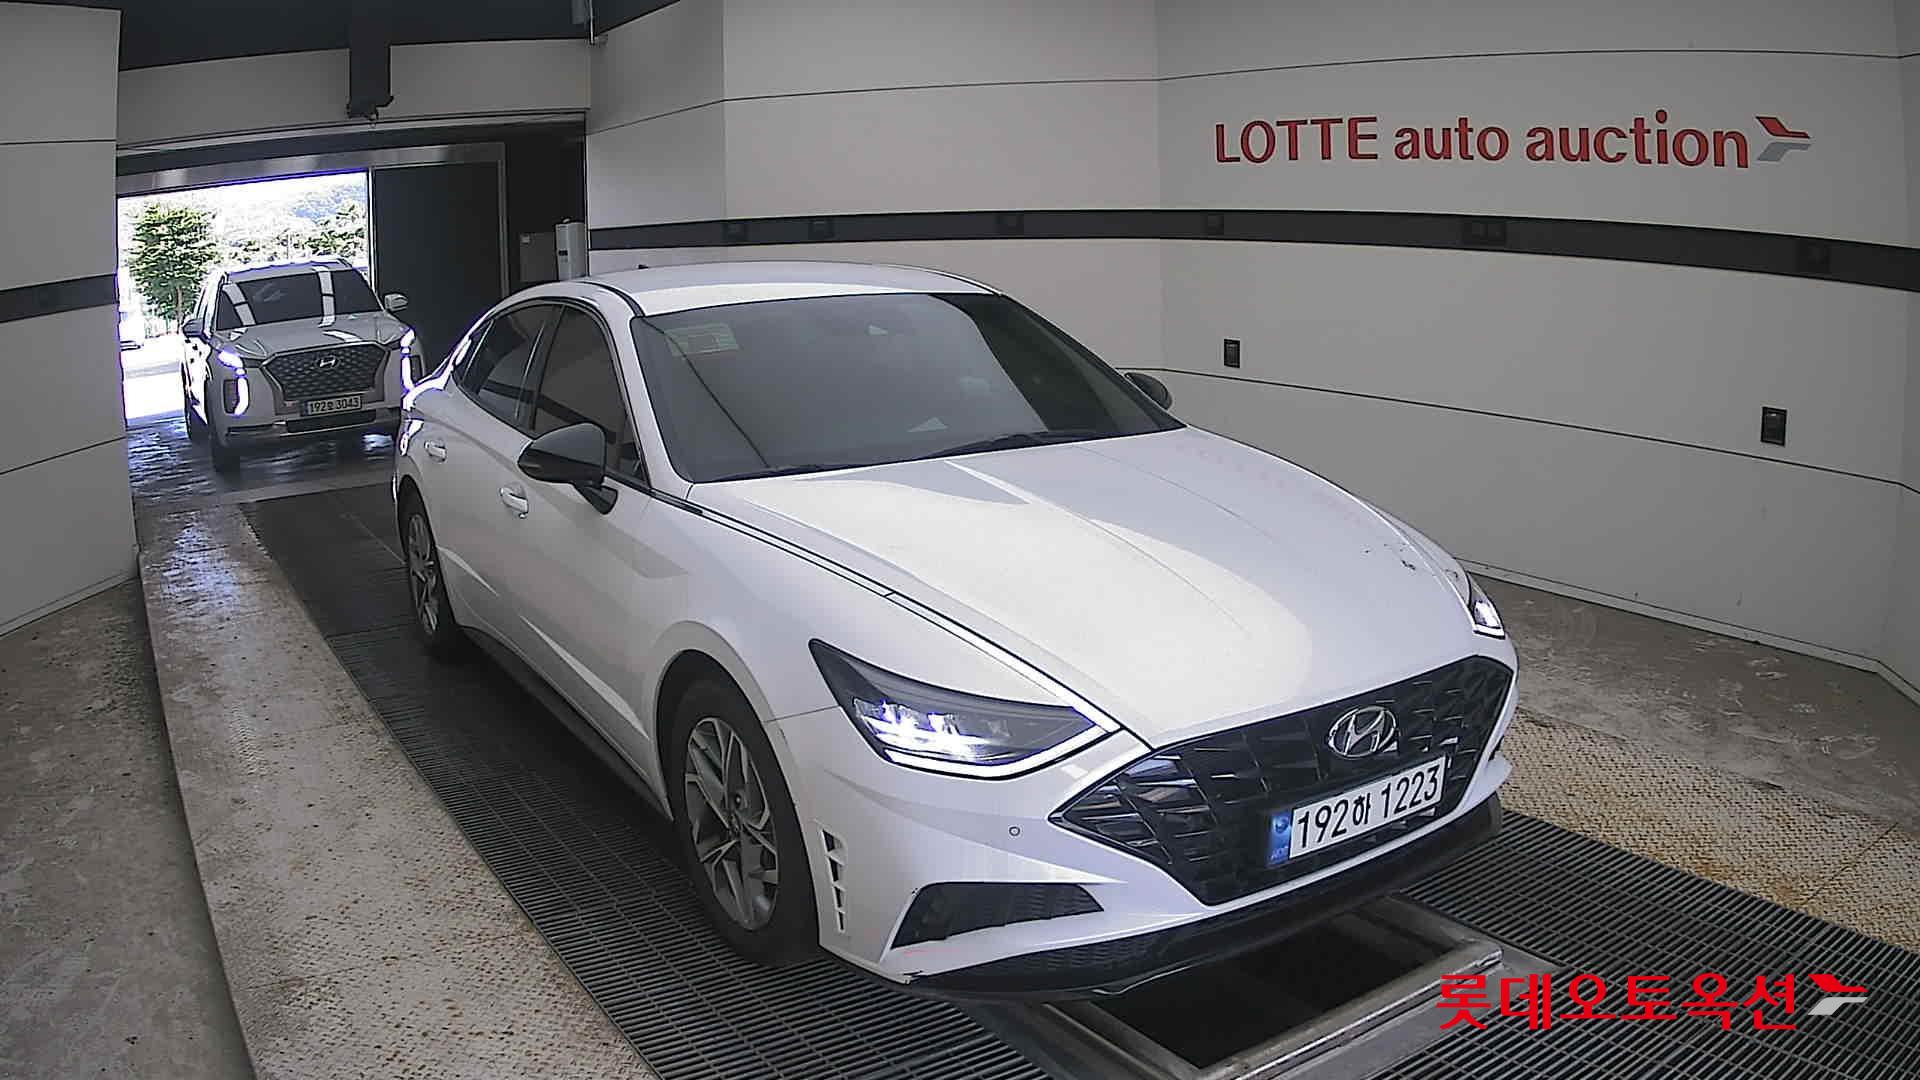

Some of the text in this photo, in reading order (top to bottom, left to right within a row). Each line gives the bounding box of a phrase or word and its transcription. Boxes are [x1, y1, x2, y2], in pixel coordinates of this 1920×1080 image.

[1215, 110, 1750, 169] LOTTE auto auction
[1298, 764, 1440, 848] 192하 1223
